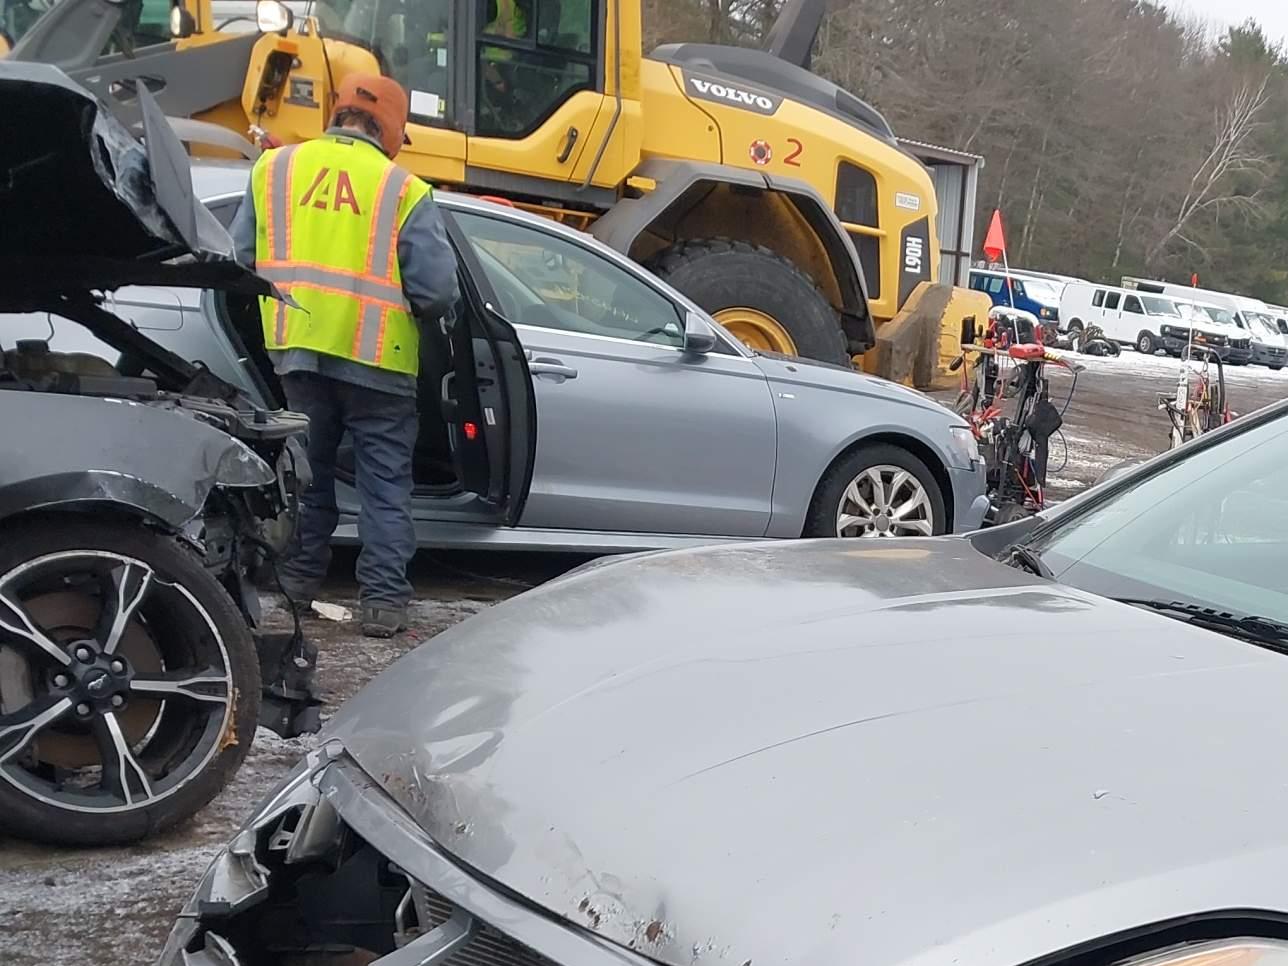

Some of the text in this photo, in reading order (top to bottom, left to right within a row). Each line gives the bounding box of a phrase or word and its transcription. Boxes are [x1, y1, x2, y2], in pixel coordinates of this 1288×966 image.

[690, 79, 773, 109] VOLVO
[783, 138, 803, 167] 2
[905, 236, 922, 273] L90H
